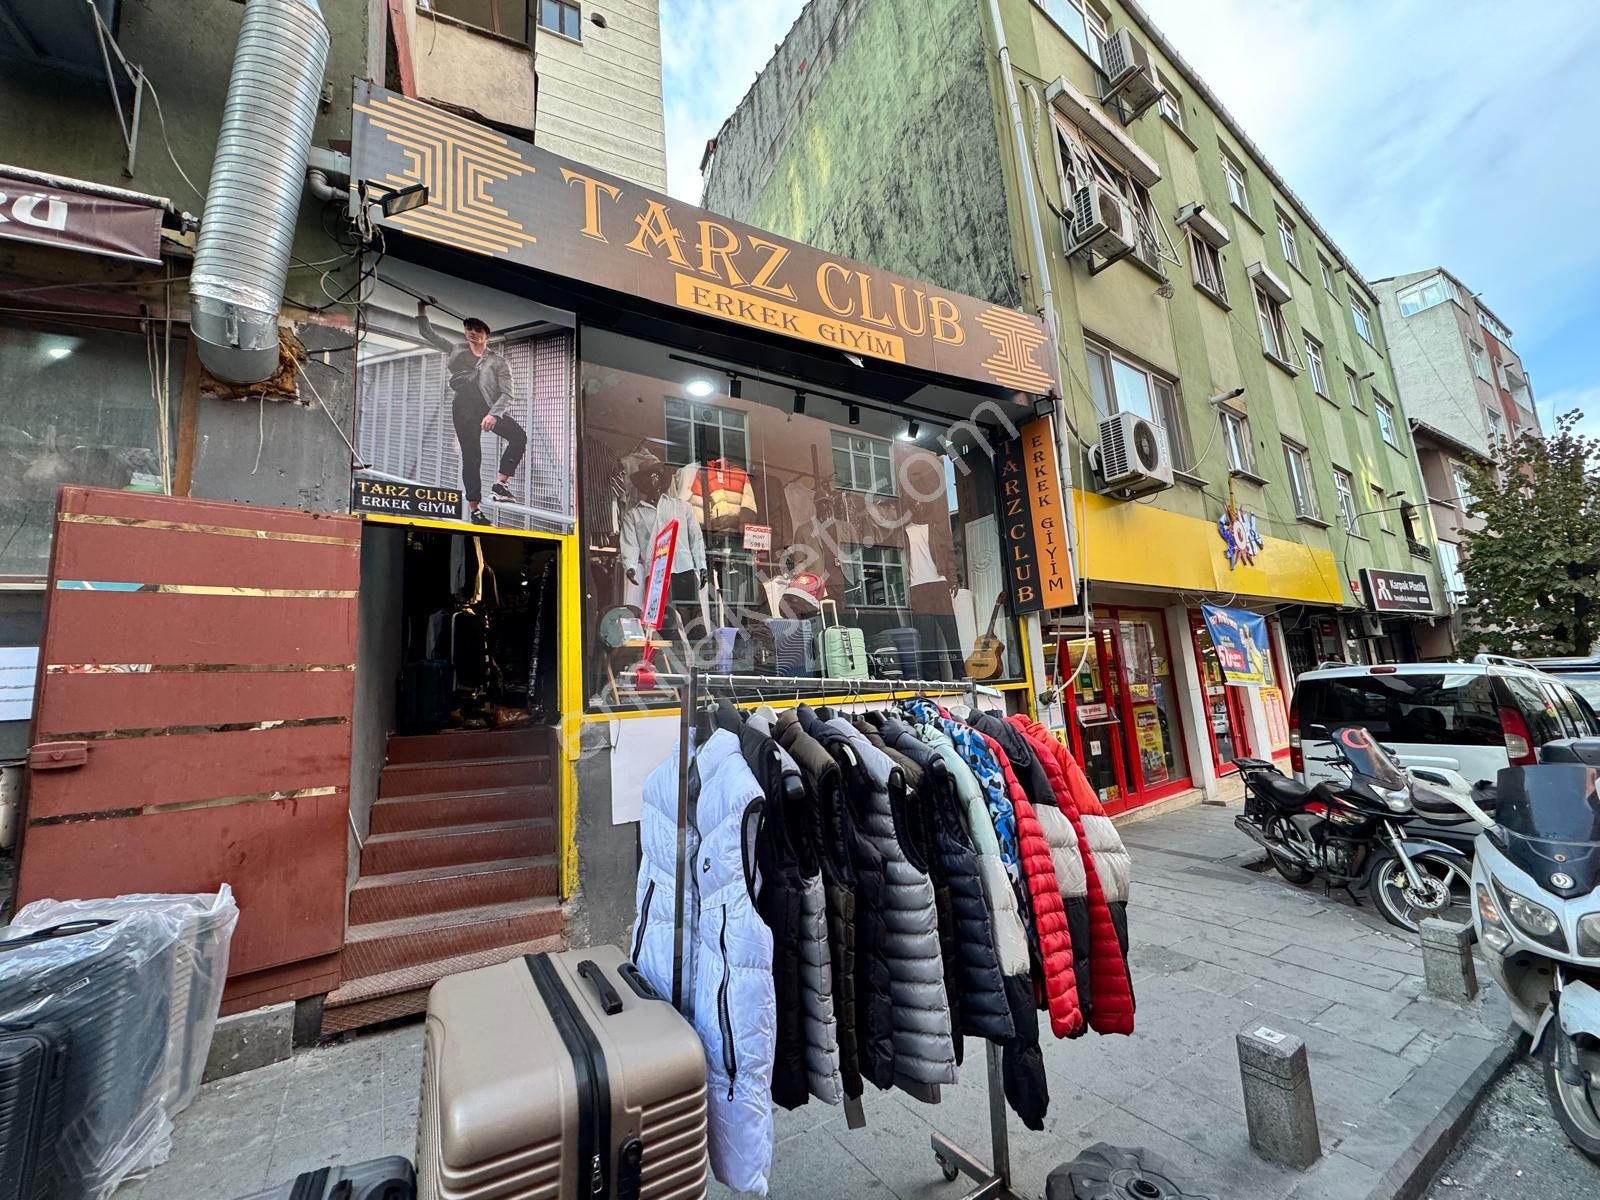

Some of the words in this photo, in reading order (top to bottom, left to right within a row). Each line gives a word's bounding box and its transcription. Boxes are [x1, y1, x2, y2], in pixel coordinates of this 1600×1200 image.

[559, 166, 798, 303] TARZ
[815, 261, 967, 347] CLUB
[691, 284, 802, 334] ERKEK
[817, 322, 896, 359] GİYİM
[359, 482, 410, 498] TARZ
[415, 488, 459, 503] CLUB
[362, 496, 411, 510] ERKEK
[418, 501, 456, 515] GİYİM
[1000, 439, 1025, 517] TARZ
[1031, 434, 1051, 508] ERKEK
[1041, 516, 1064, 593] GİYİM
[1009, 523, 1035, 605] CLUB
